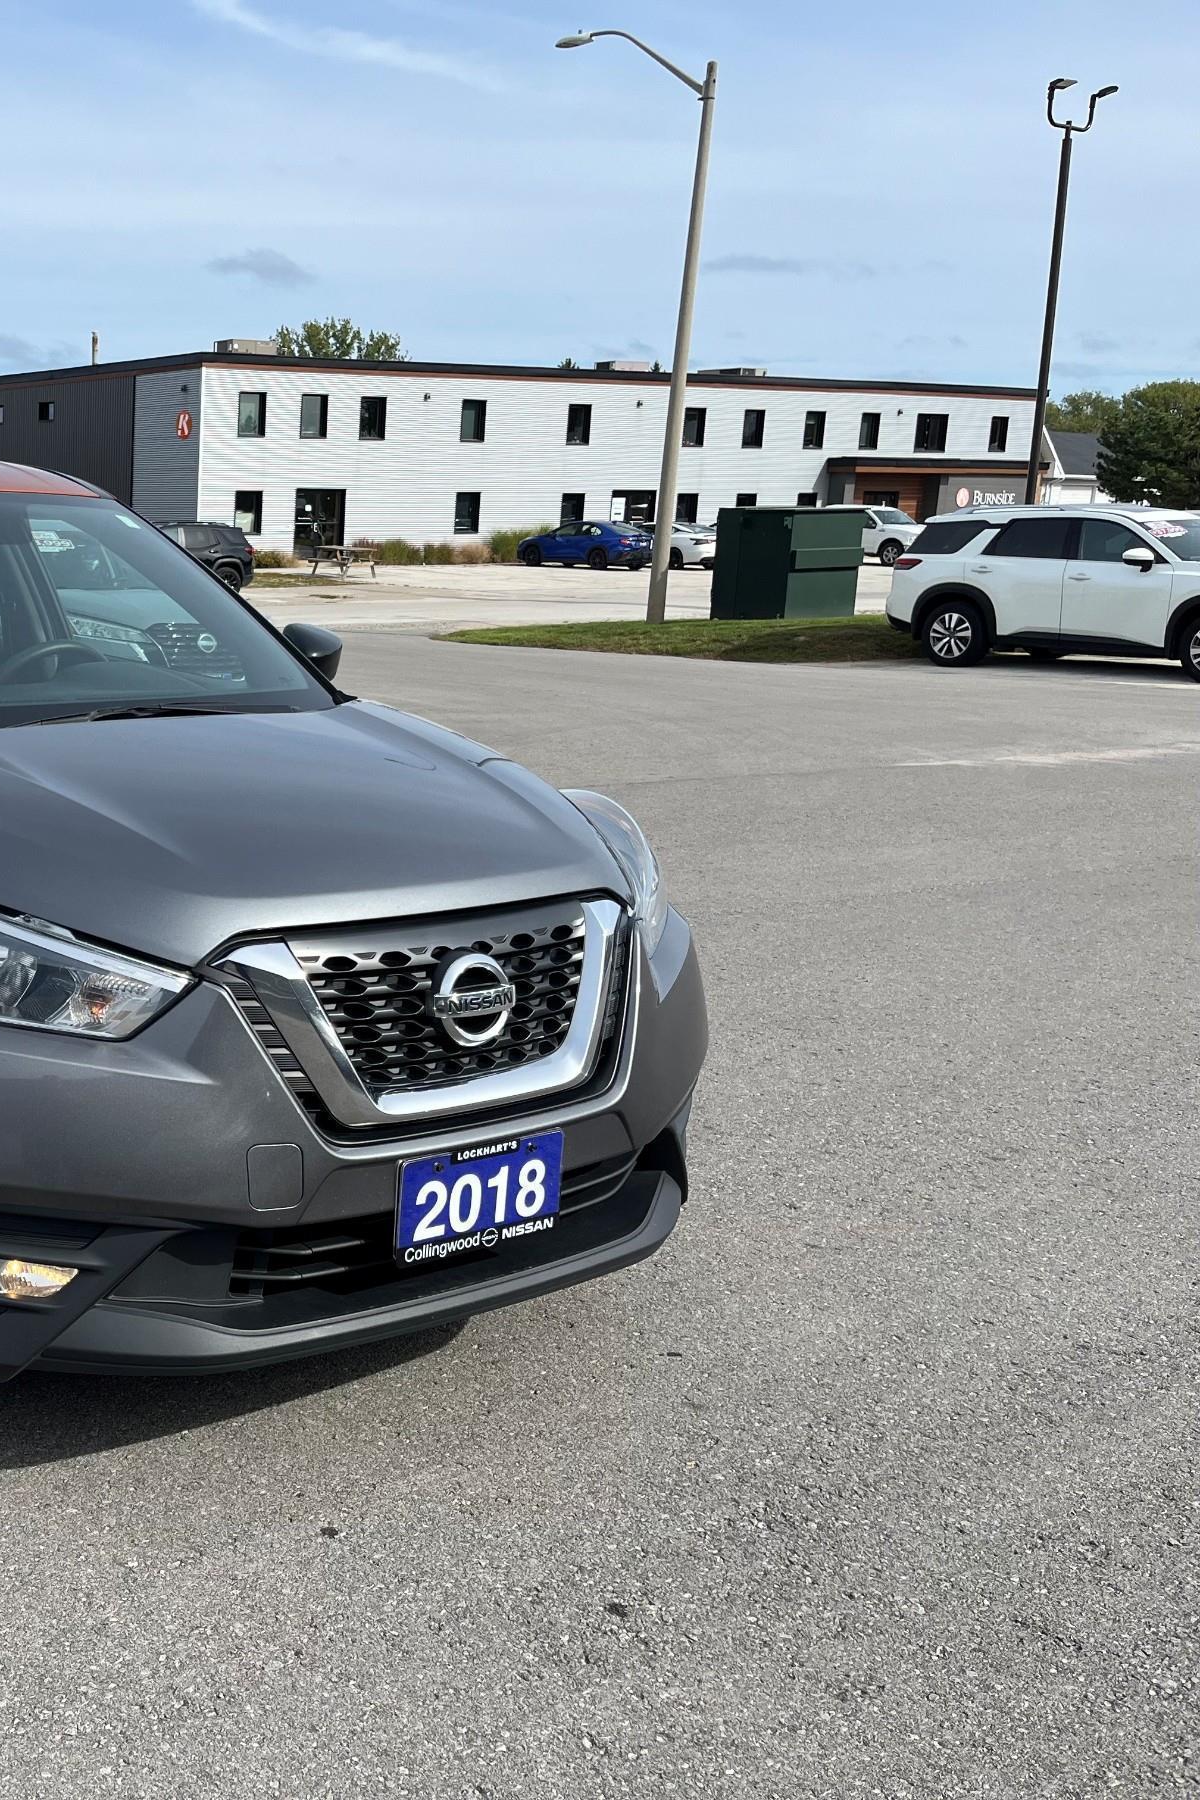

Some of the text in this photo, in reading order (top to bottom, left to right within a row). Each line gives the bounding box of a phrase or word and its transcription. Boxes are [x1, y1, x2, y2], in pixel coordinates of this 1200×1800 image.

[447, 988, 514, 1015] NISSAN
[456, 1140, 518, 1161] LOCKHART'S
[413, 1159, 547, 1243] 2018
[404, 1232, 480, 1263] Collingwood
[501, 1217, 554, 1240] NISSAN
